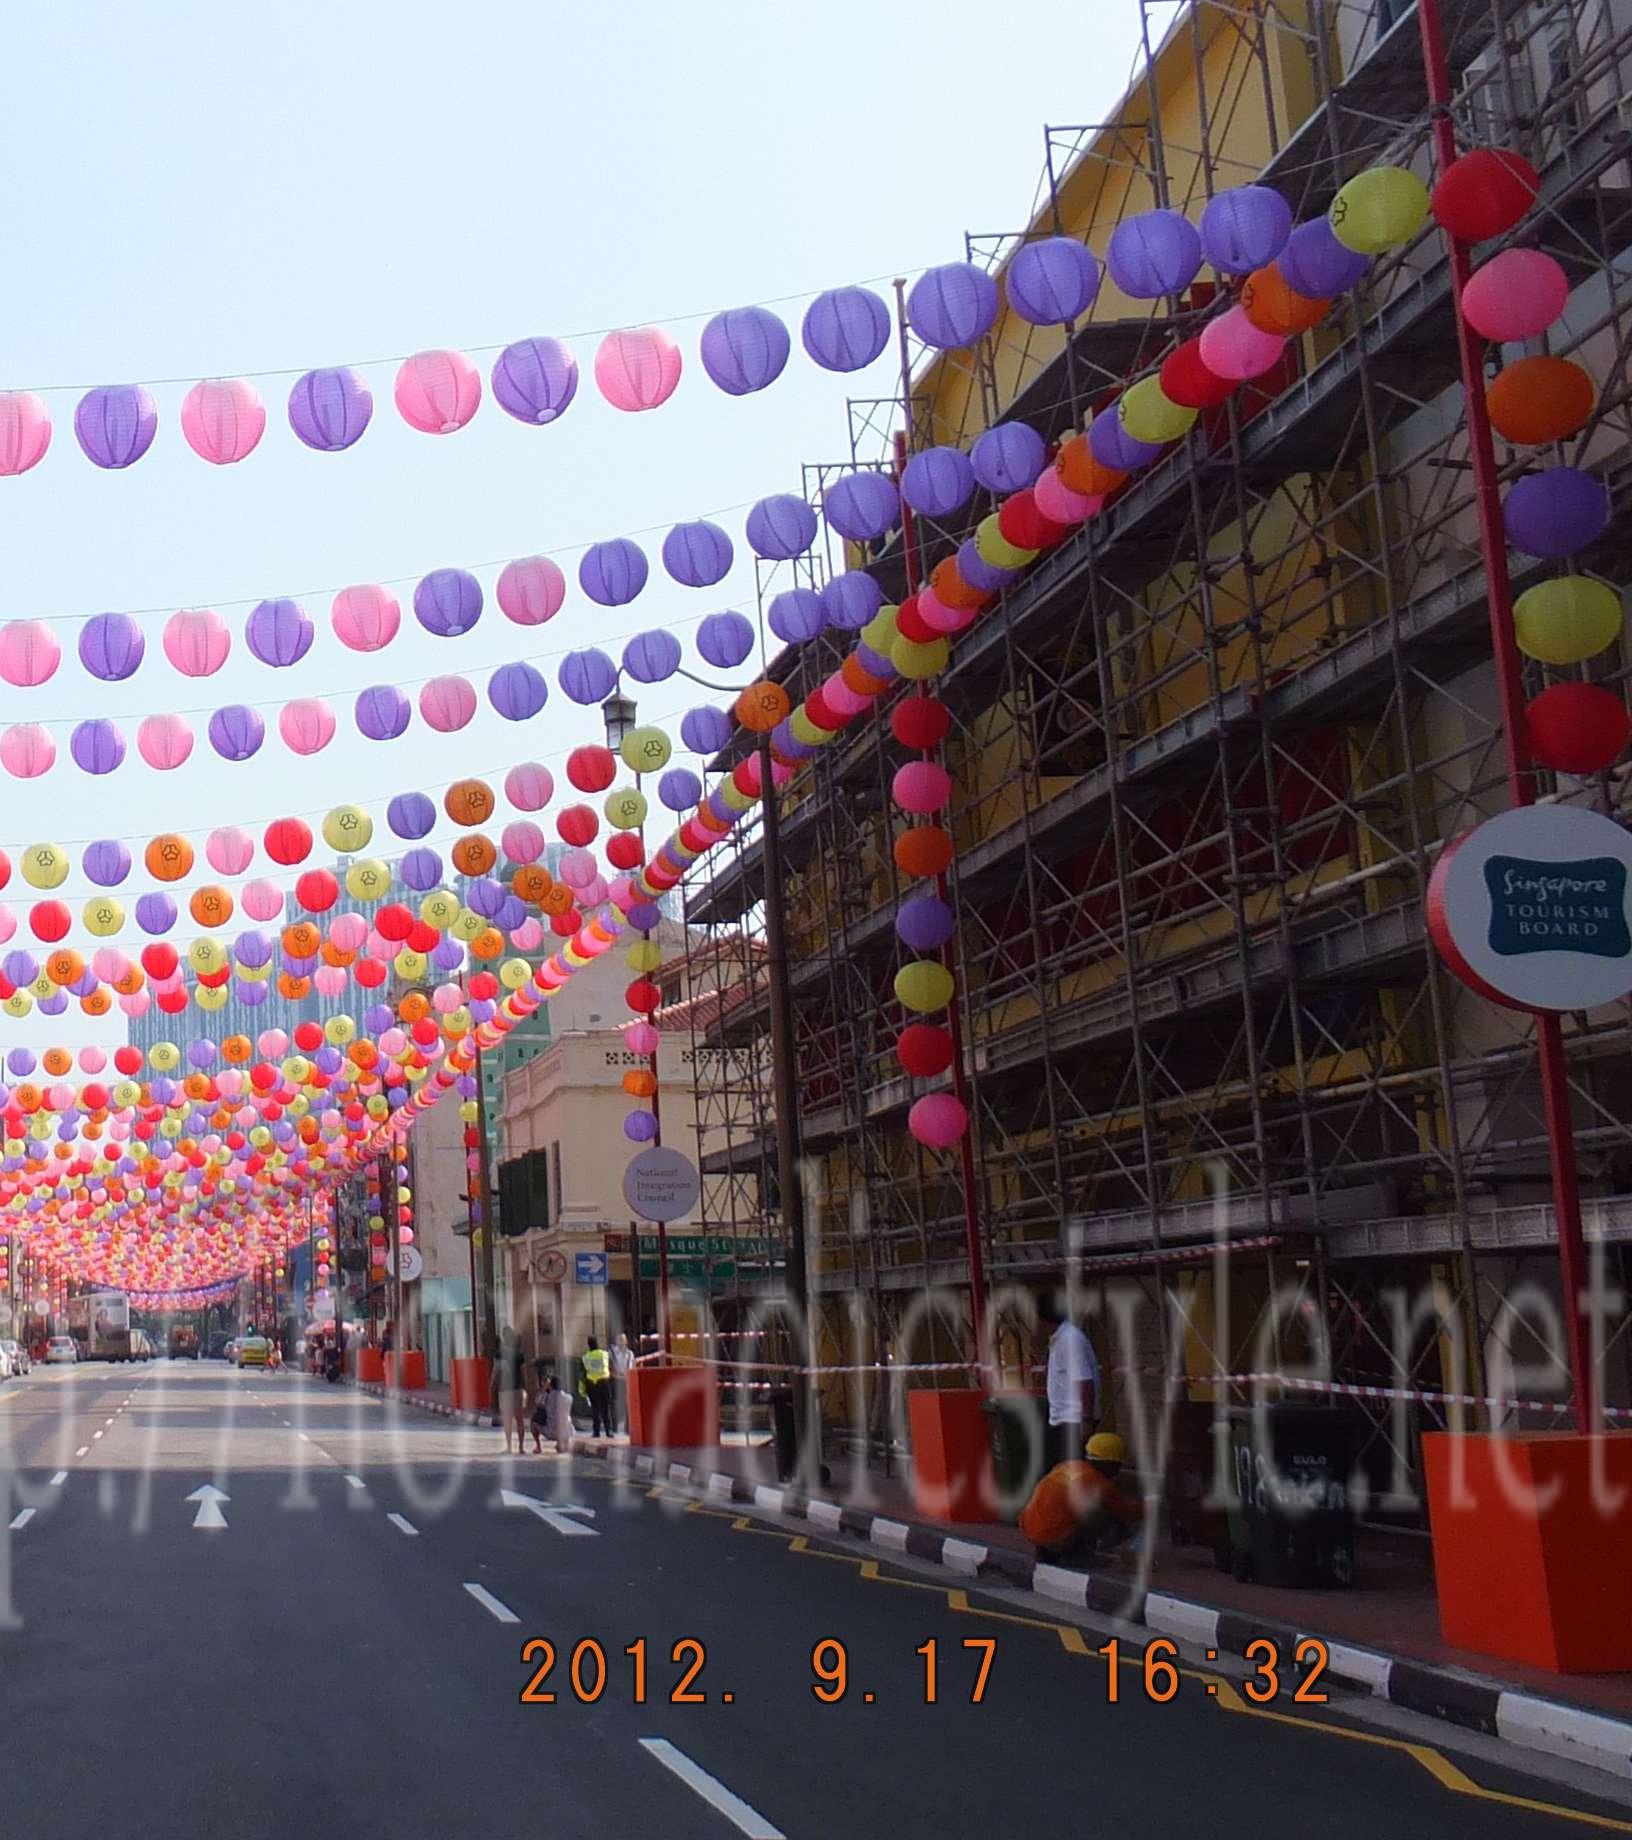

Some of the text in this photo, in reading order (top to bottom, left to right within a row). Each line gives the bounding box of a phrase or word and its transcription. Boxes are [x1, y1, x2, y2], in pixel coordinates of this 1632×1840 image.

[1503, 868, 1608, 902] Singapore
[1504, 903, 1609, 920] TOURISM
[1519, 921, 1599, 936] BOARD
[644, 1237, 705, 1254] Msque
